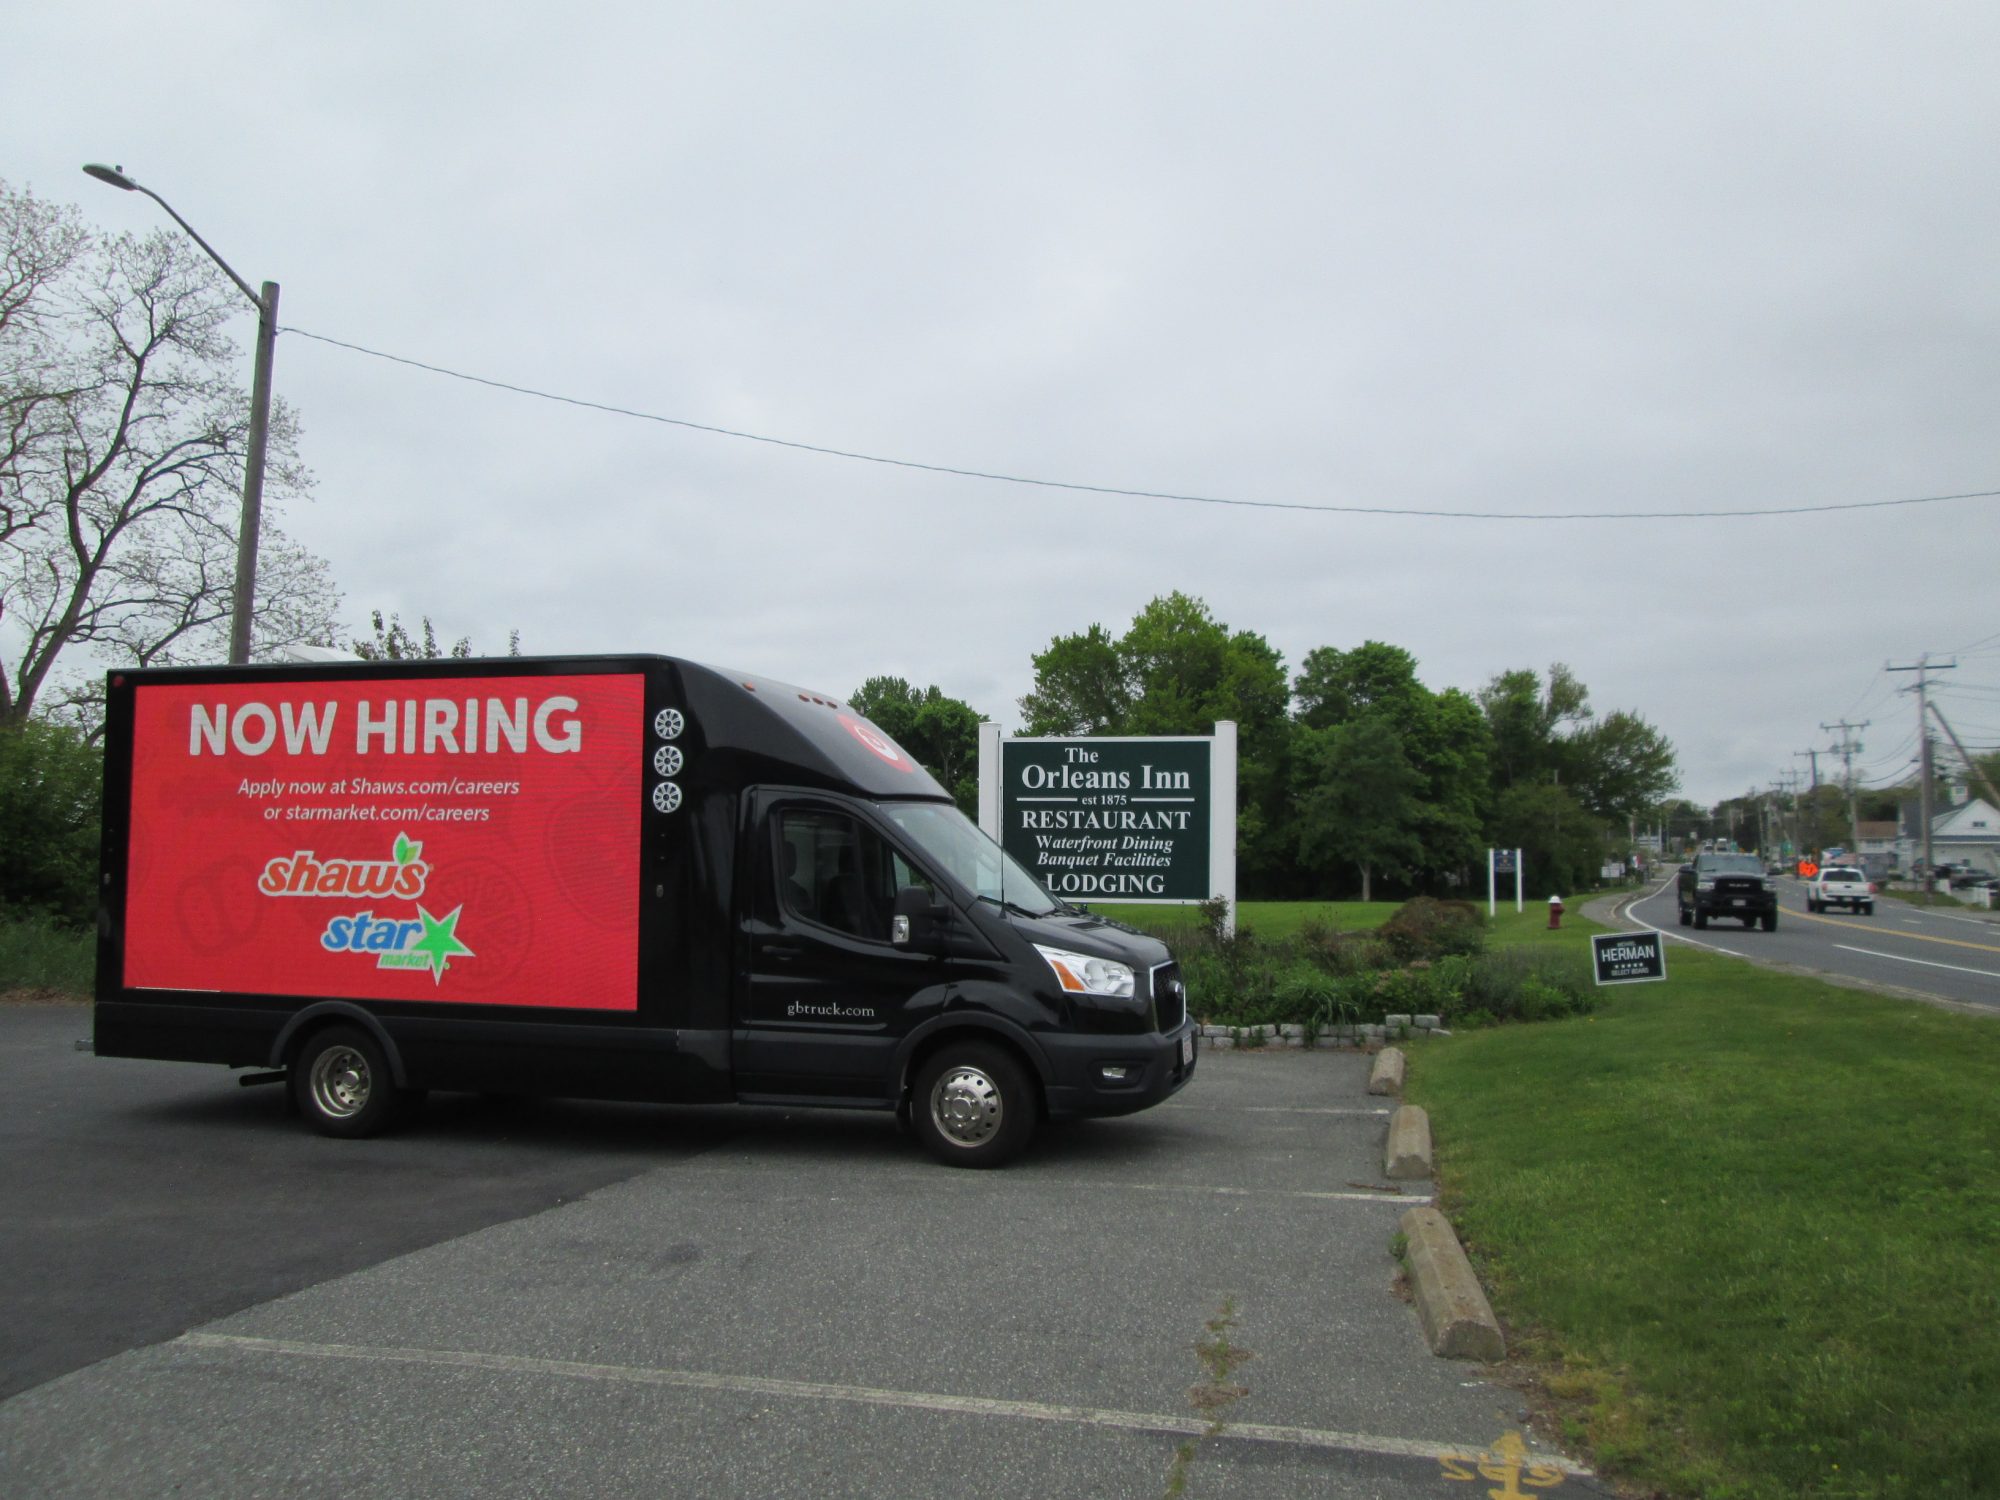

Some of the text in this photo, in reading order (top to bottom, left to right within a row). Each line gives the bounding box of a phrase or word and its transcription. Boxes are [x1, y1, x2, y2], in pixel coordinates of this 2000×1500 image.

[189, 696, 582, 756] NOW HIRING
[1065, 747, 1099, 763] The
[1021, 765, 1191, 789] Orleans Inn
[238, 777, 520, 798] Apply now at Shaws.com/careers
[1081, 794, 1127, 805] est 1875
[264, 803, 490, 821] or starmarket.com/careers
[1021, 811, 1191, 830] RESTAURANT
[1035, 835, 1174, 853] Waterfront Dining
[1037, 852, 1172, 870] Banquet Facilities
[1046, 873, 1166, 894] LODGING
[322, 912, 424, 952] star
[380, 954, 429, 968] market
[1601, 945, 1655, 962] HERMAN
[787, 1000, 875, 1016] gbtruck.com
